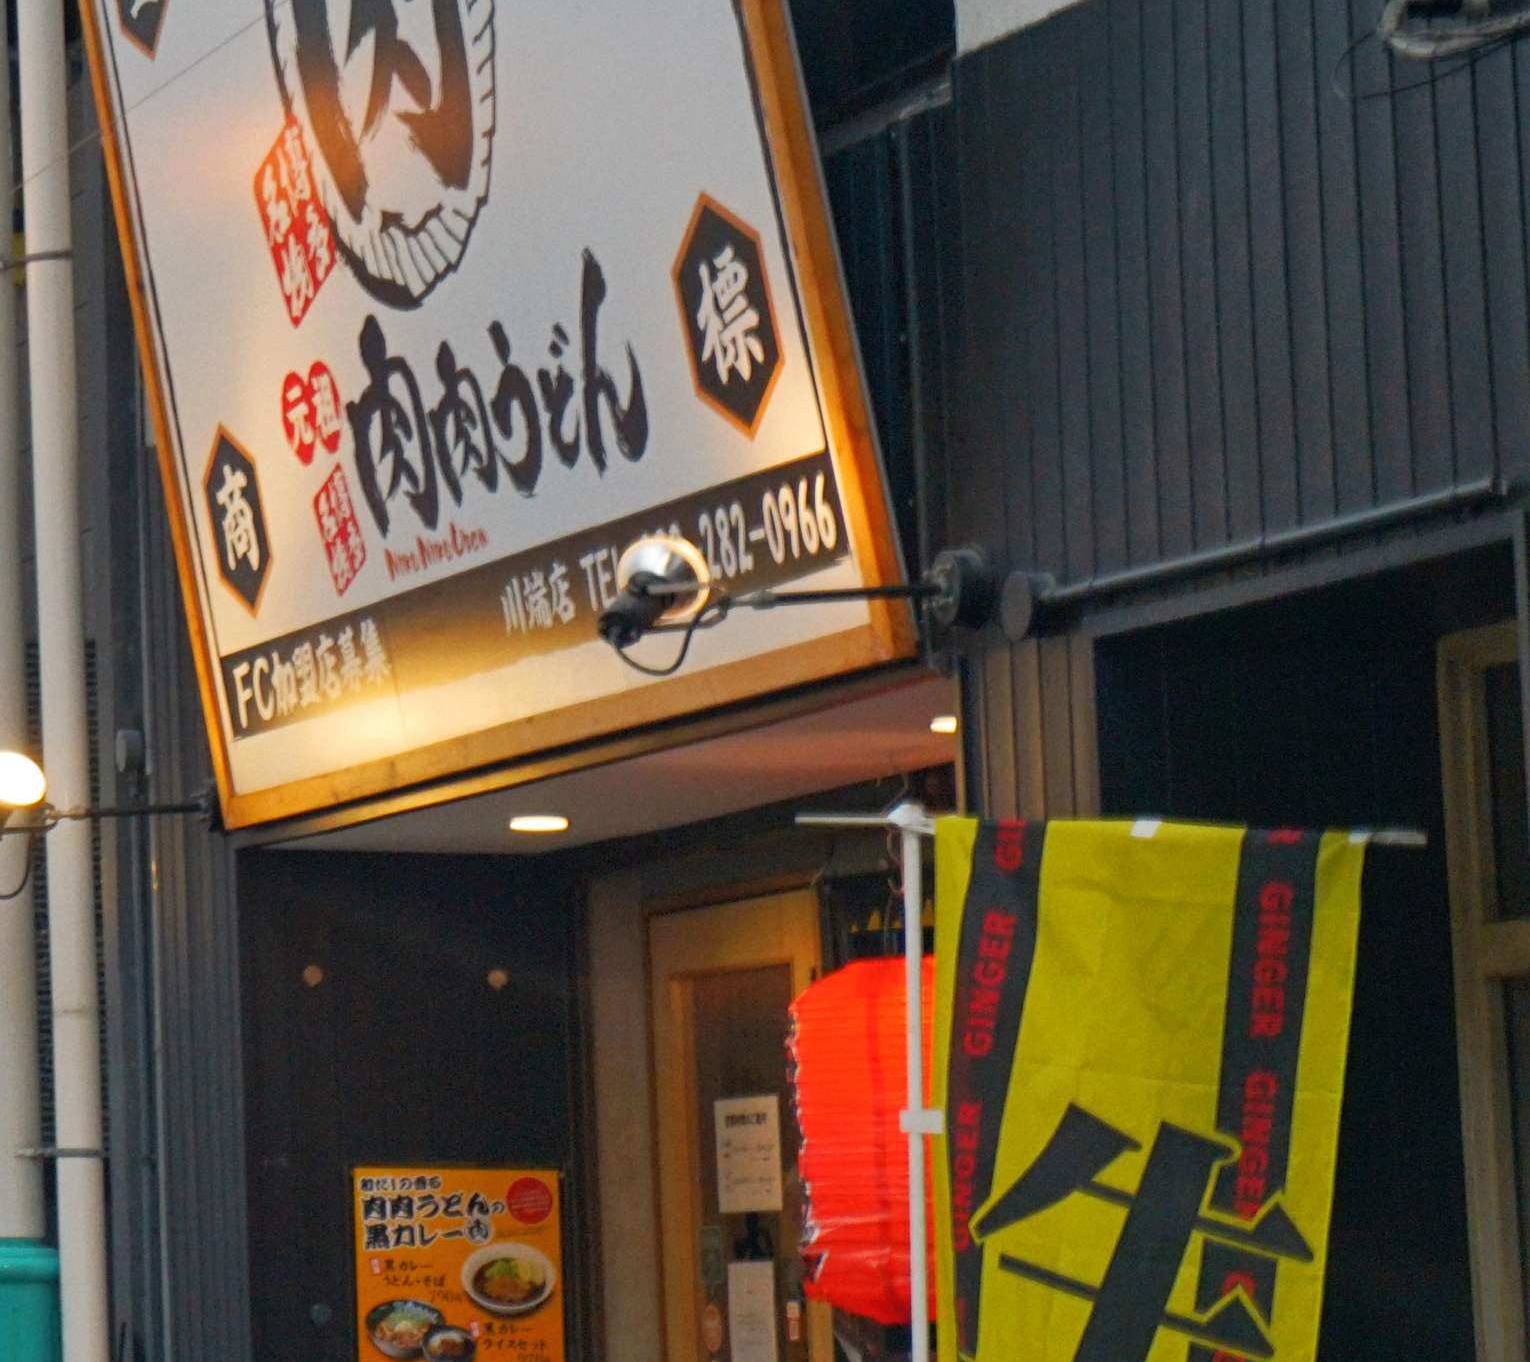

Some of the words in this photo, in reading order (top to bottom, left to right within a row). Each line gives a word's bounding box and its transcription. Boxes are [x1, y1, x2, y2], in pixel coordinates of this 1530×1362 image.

[695, 243, 770, 383] 標
[346, 245, 650, 539] 肉肉うどん
[214, 439, 265, 574] 商
[501, 565, 577, 635] 川端店
[231, 619, 393, 727] FC加盟店募集
[963, 909, 1019, 1058] GINGER
[1247, 881, 1295, 1040] GINGER
[362, 1193, 506, 1221] 肉肉うどんの
[364, 1222, 465, 1250] 黒カレー
